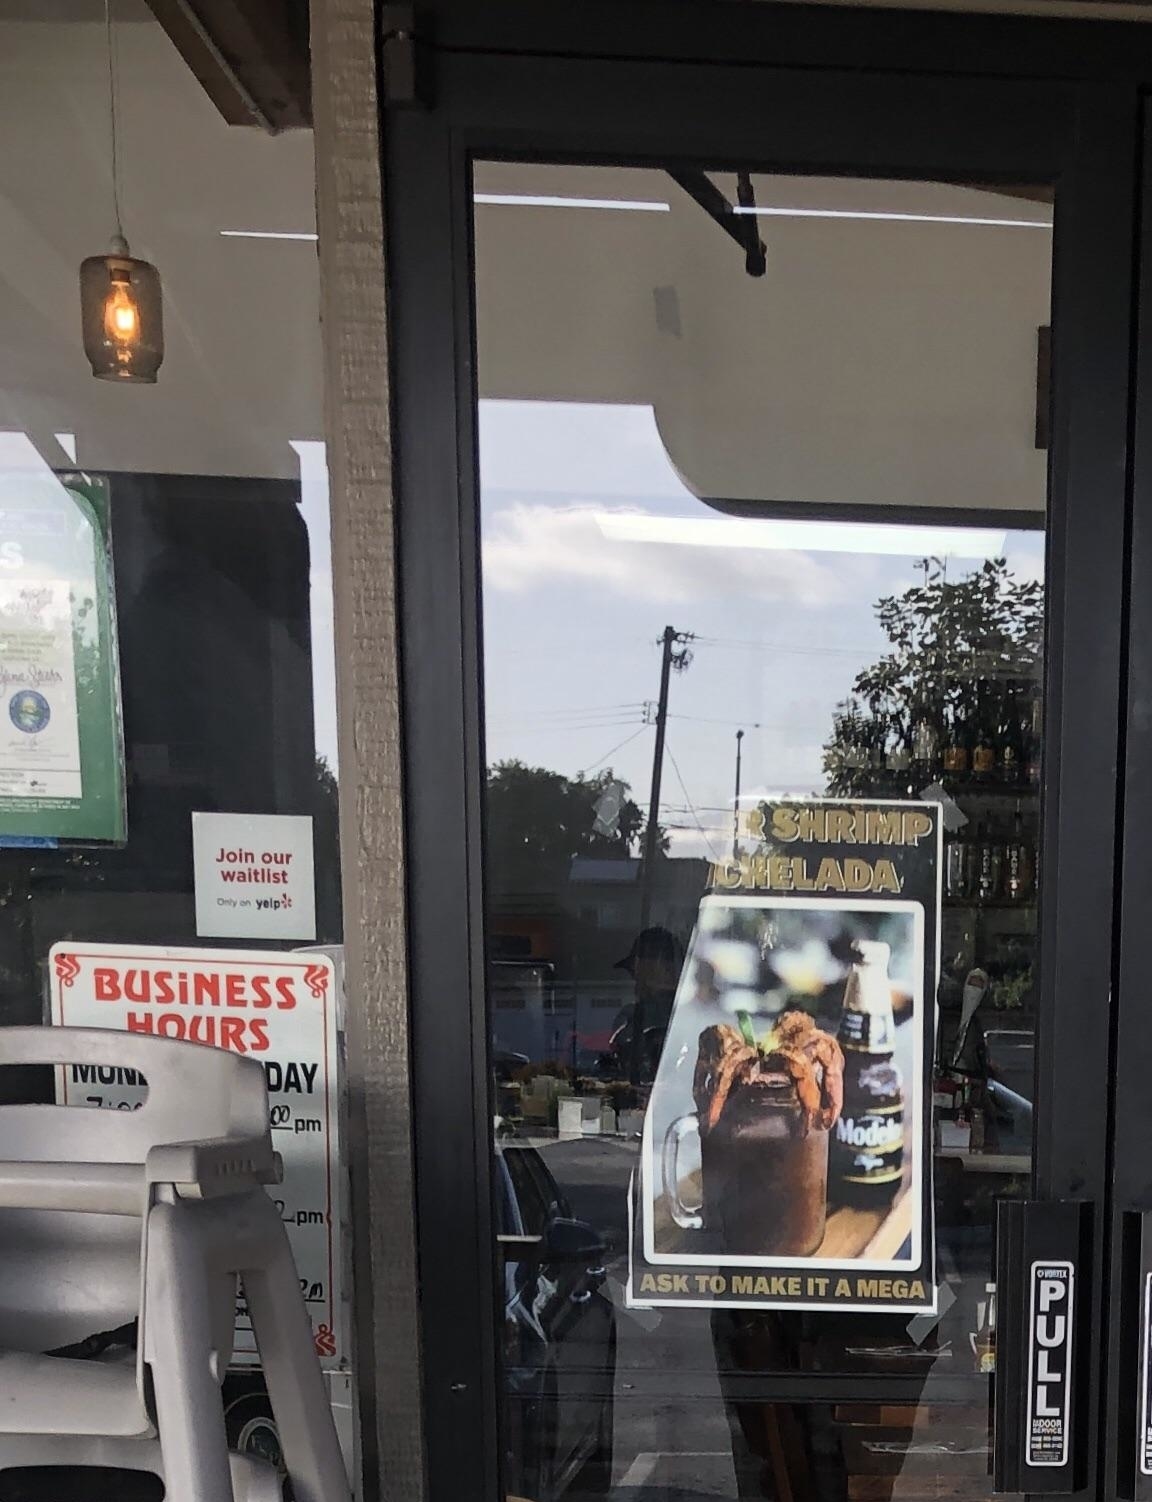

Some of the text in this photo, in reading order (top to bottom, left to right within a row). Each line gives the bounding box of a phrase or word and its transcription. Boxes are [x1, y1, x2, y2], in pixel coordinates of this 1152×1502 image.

[772, 808, 933, 848] SHRIMP
[216, 848, 292, 865] Join our
[221, 867, 288, 884] waitlist
[217, 898, 238, 908] Only
[256, 897, 281, 910] yelp
[127, 1012, 270, 1053] HOURS
[260, 1061, 318, 1094] DAY
[295, 1119, 322, 1134] pm
[297, 1211, 323, 1226] pm
[640, 1273, 926, 1299] ASK TO MAKE IT A MEGA
[1036, 1280, 1066, 1416] PULL
